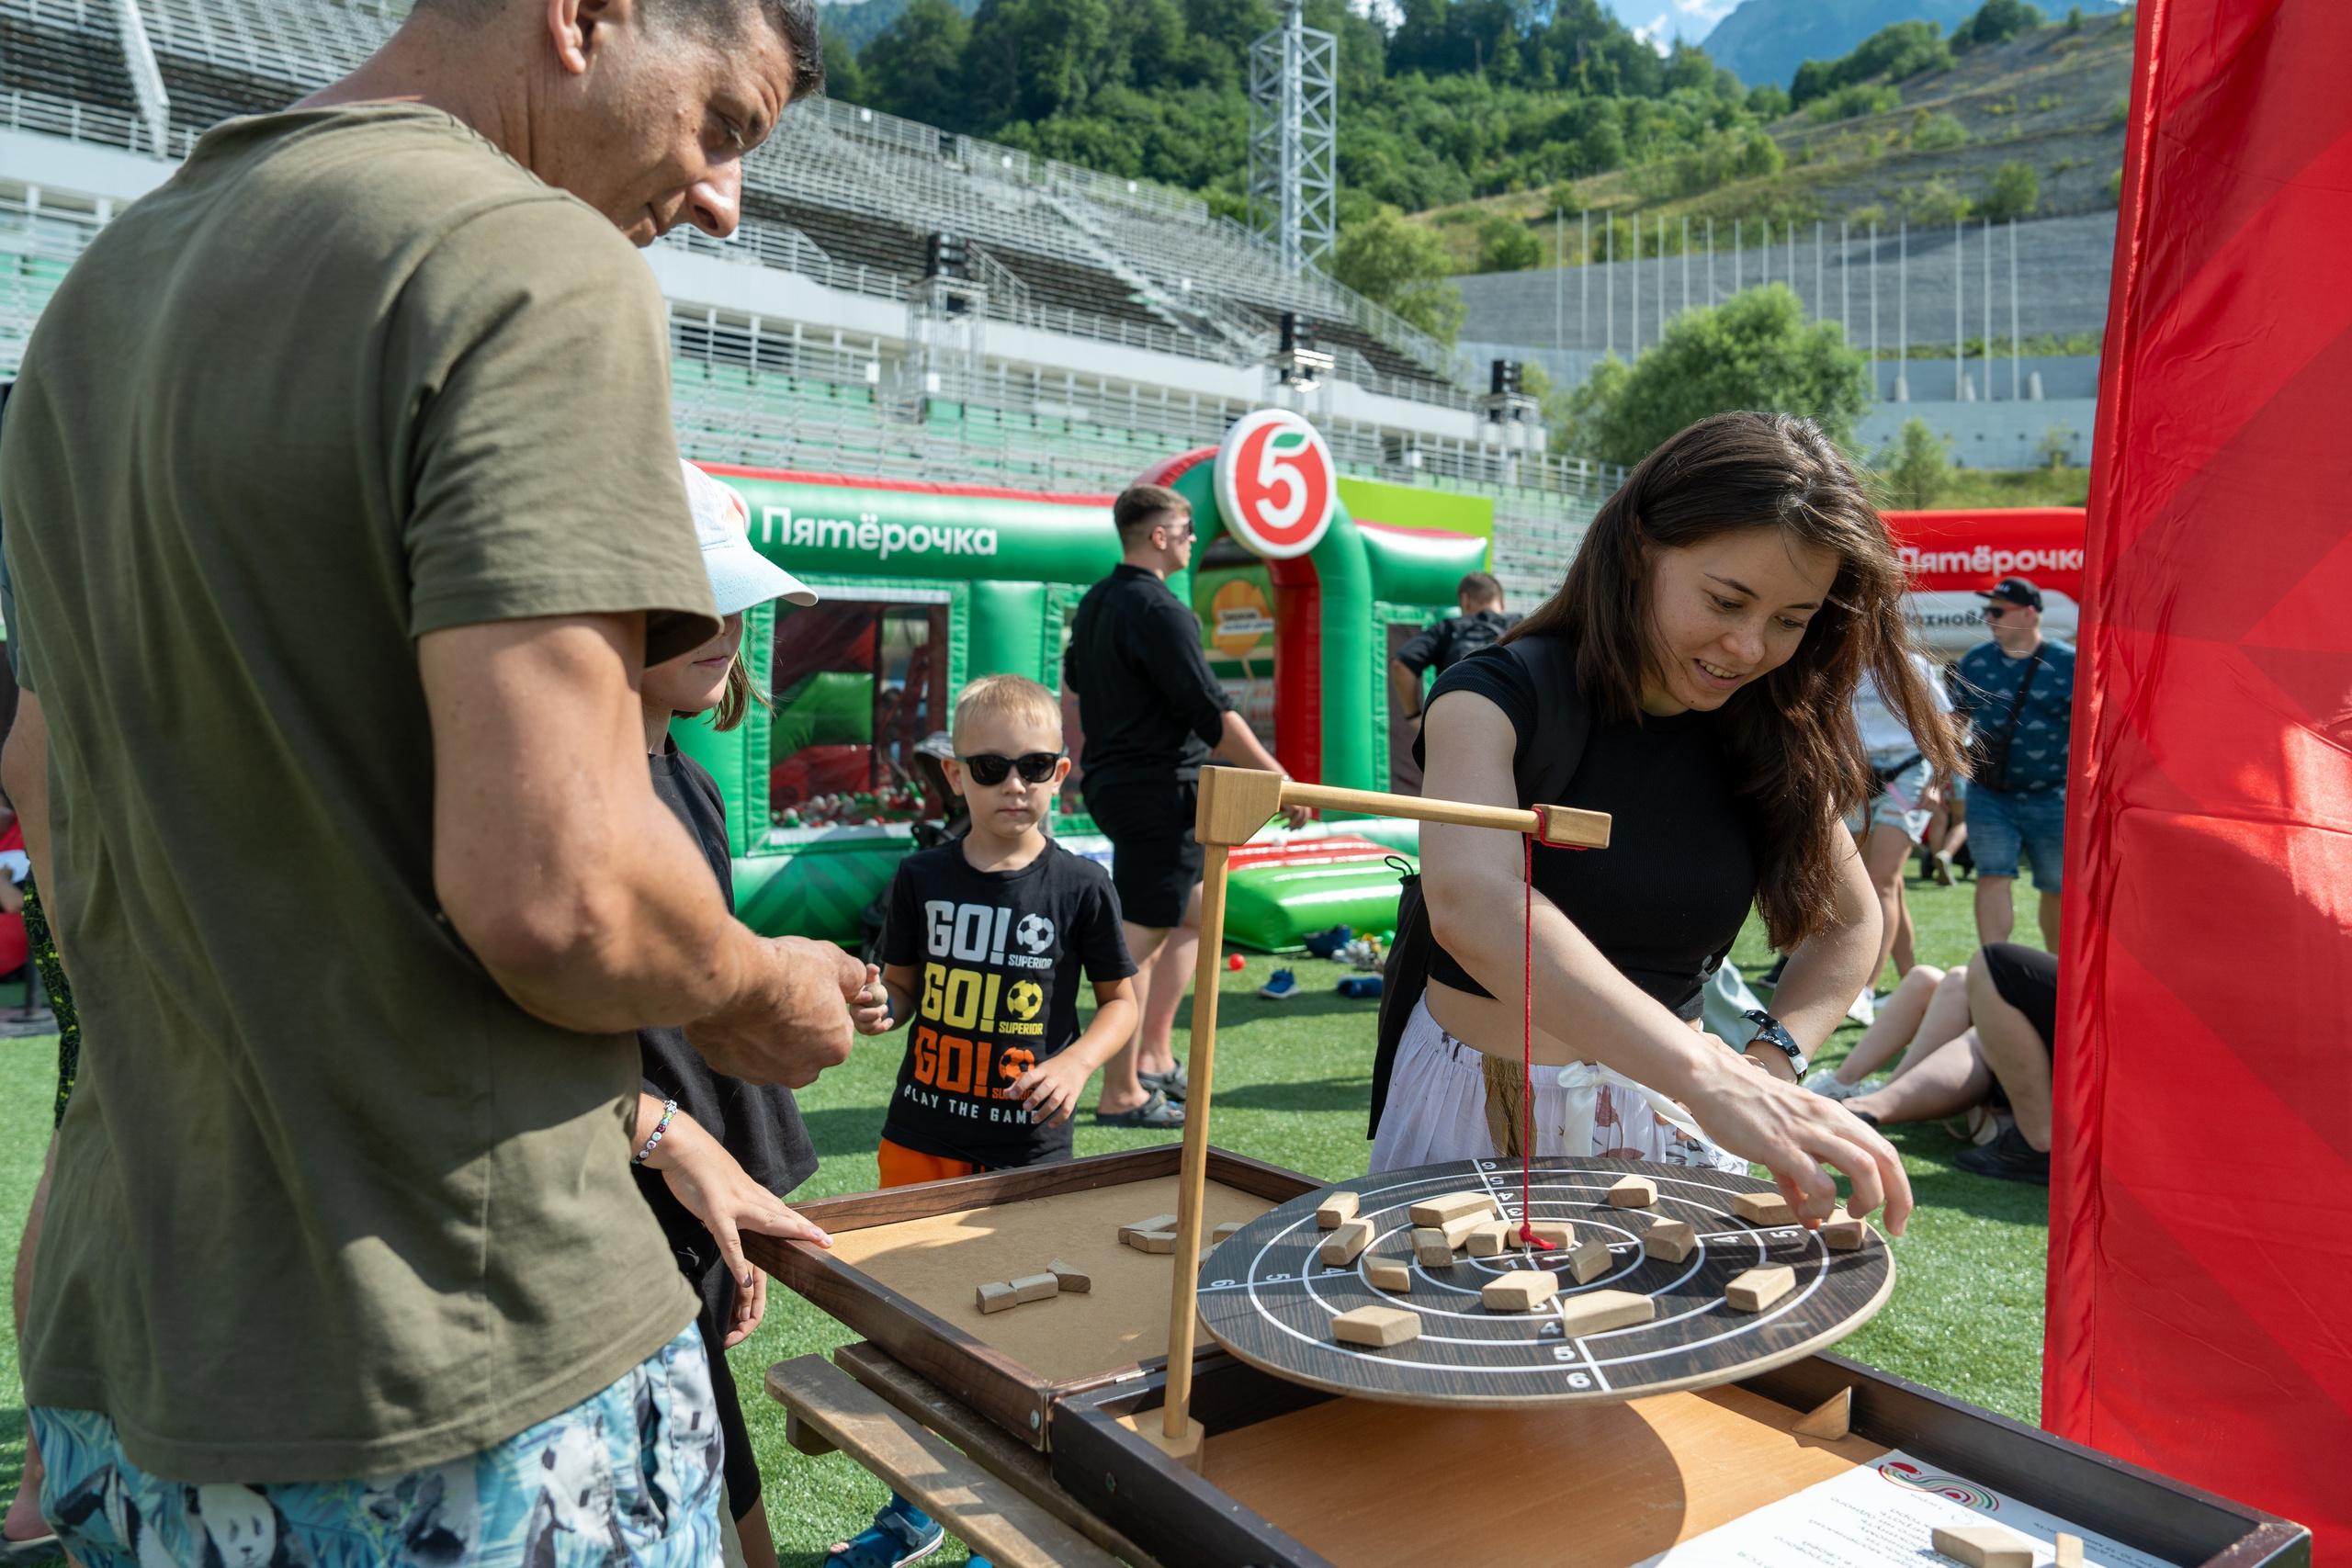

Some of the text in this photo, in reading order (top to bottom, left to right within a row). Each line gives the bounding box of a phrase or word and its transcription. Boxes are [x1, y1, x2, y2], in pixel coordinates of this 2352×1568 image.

[762, 505, 998, 560] Пятёрочка
[924, 900, 1012, 964] GO!
[1008, 953, 1053, 969] SUPERIOR
[921, 962, 1001, 1033] GO!
[998, 1021, 1044, 1035] SUPERIOR
[914, 1025, 992, 1098] GO!
[904, 1084, 939, 1109] PLAY
[949, 1099, 979, 1119] THE
[1498, 1192, 1514, 1201] 4
[1713, 1235, 1740, 1244] 4
[1770, 1230, 1799, 1238] 5
[1266, 1273, 1291, 1281] 5
[1322, 1267, 1346, 1275] 4
[1540, 1322, 1561, 1335] 4
[1554, 1346, 1576, 1360] 5
[1566, 1372, 1591, 1389] 6
